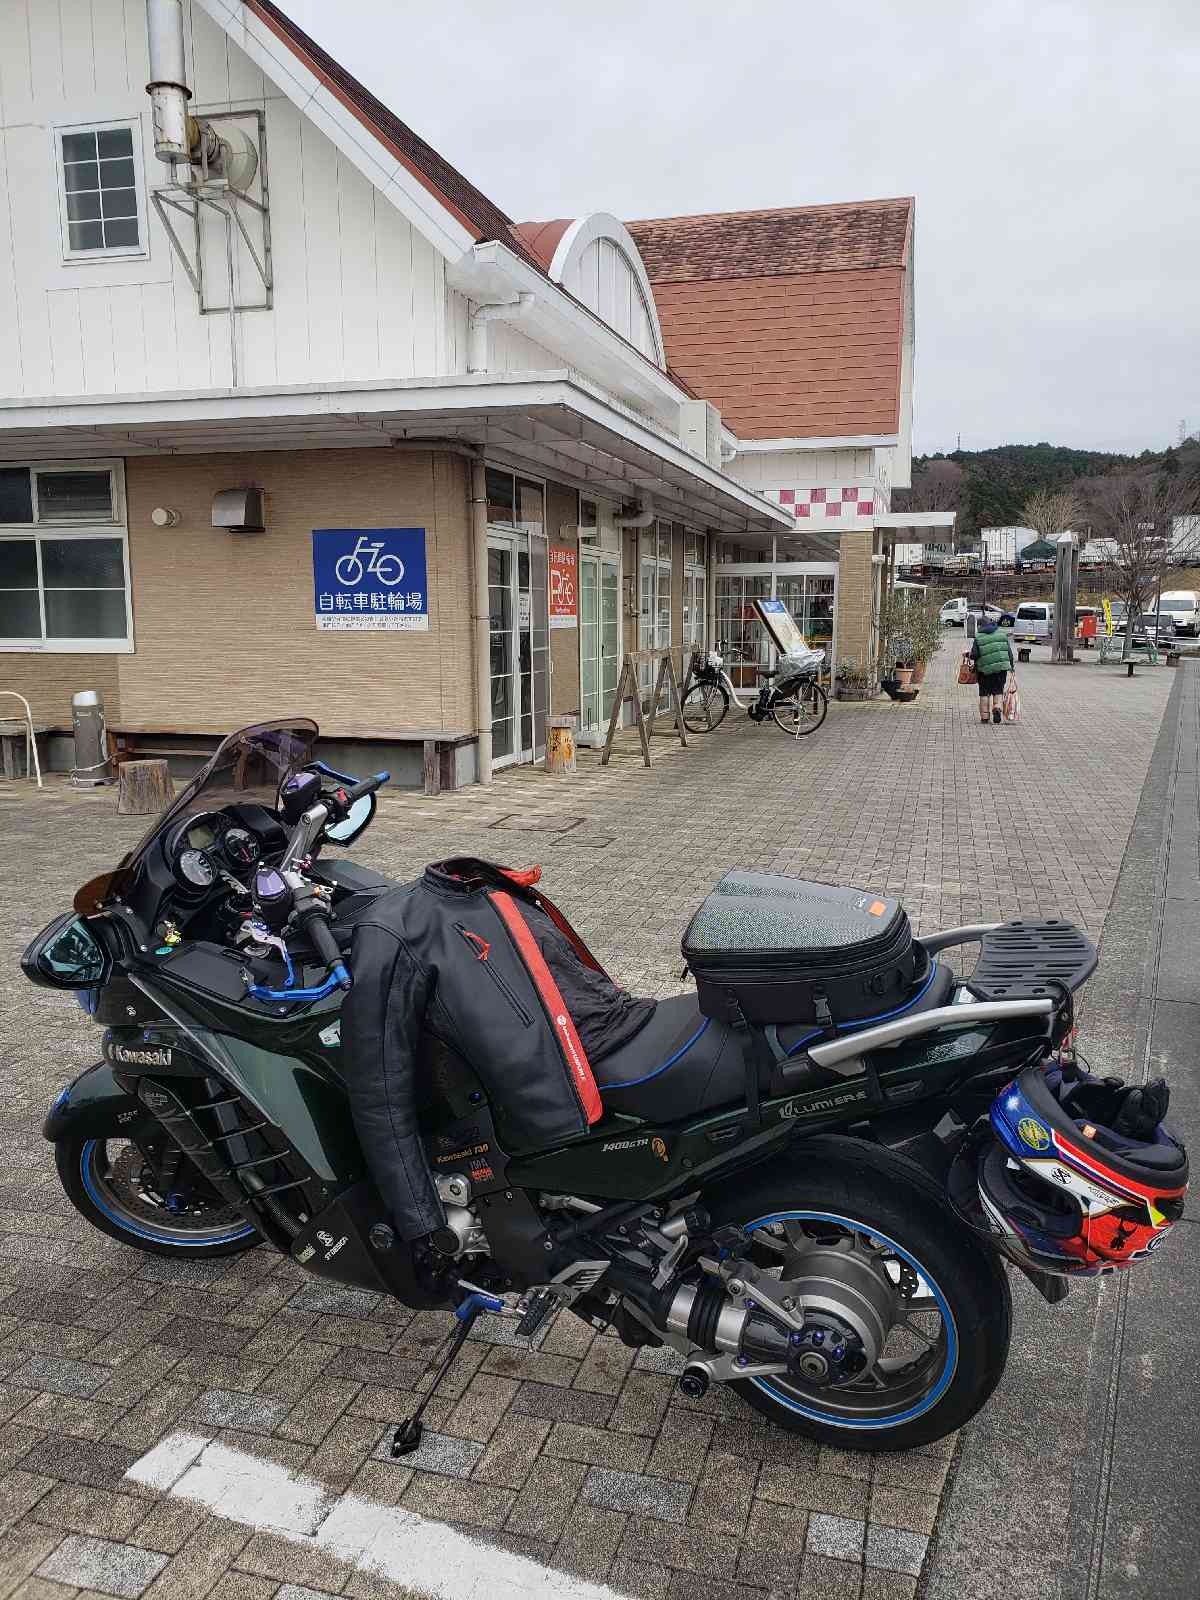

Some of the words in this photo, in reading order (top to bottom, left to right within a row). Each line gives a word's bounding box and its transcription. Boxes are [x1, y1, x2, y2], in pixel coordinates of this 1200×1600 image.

[319, 592, 423, 611] 自転車駐輪場
[115, 1045, 172, 1066] Kawasaki
